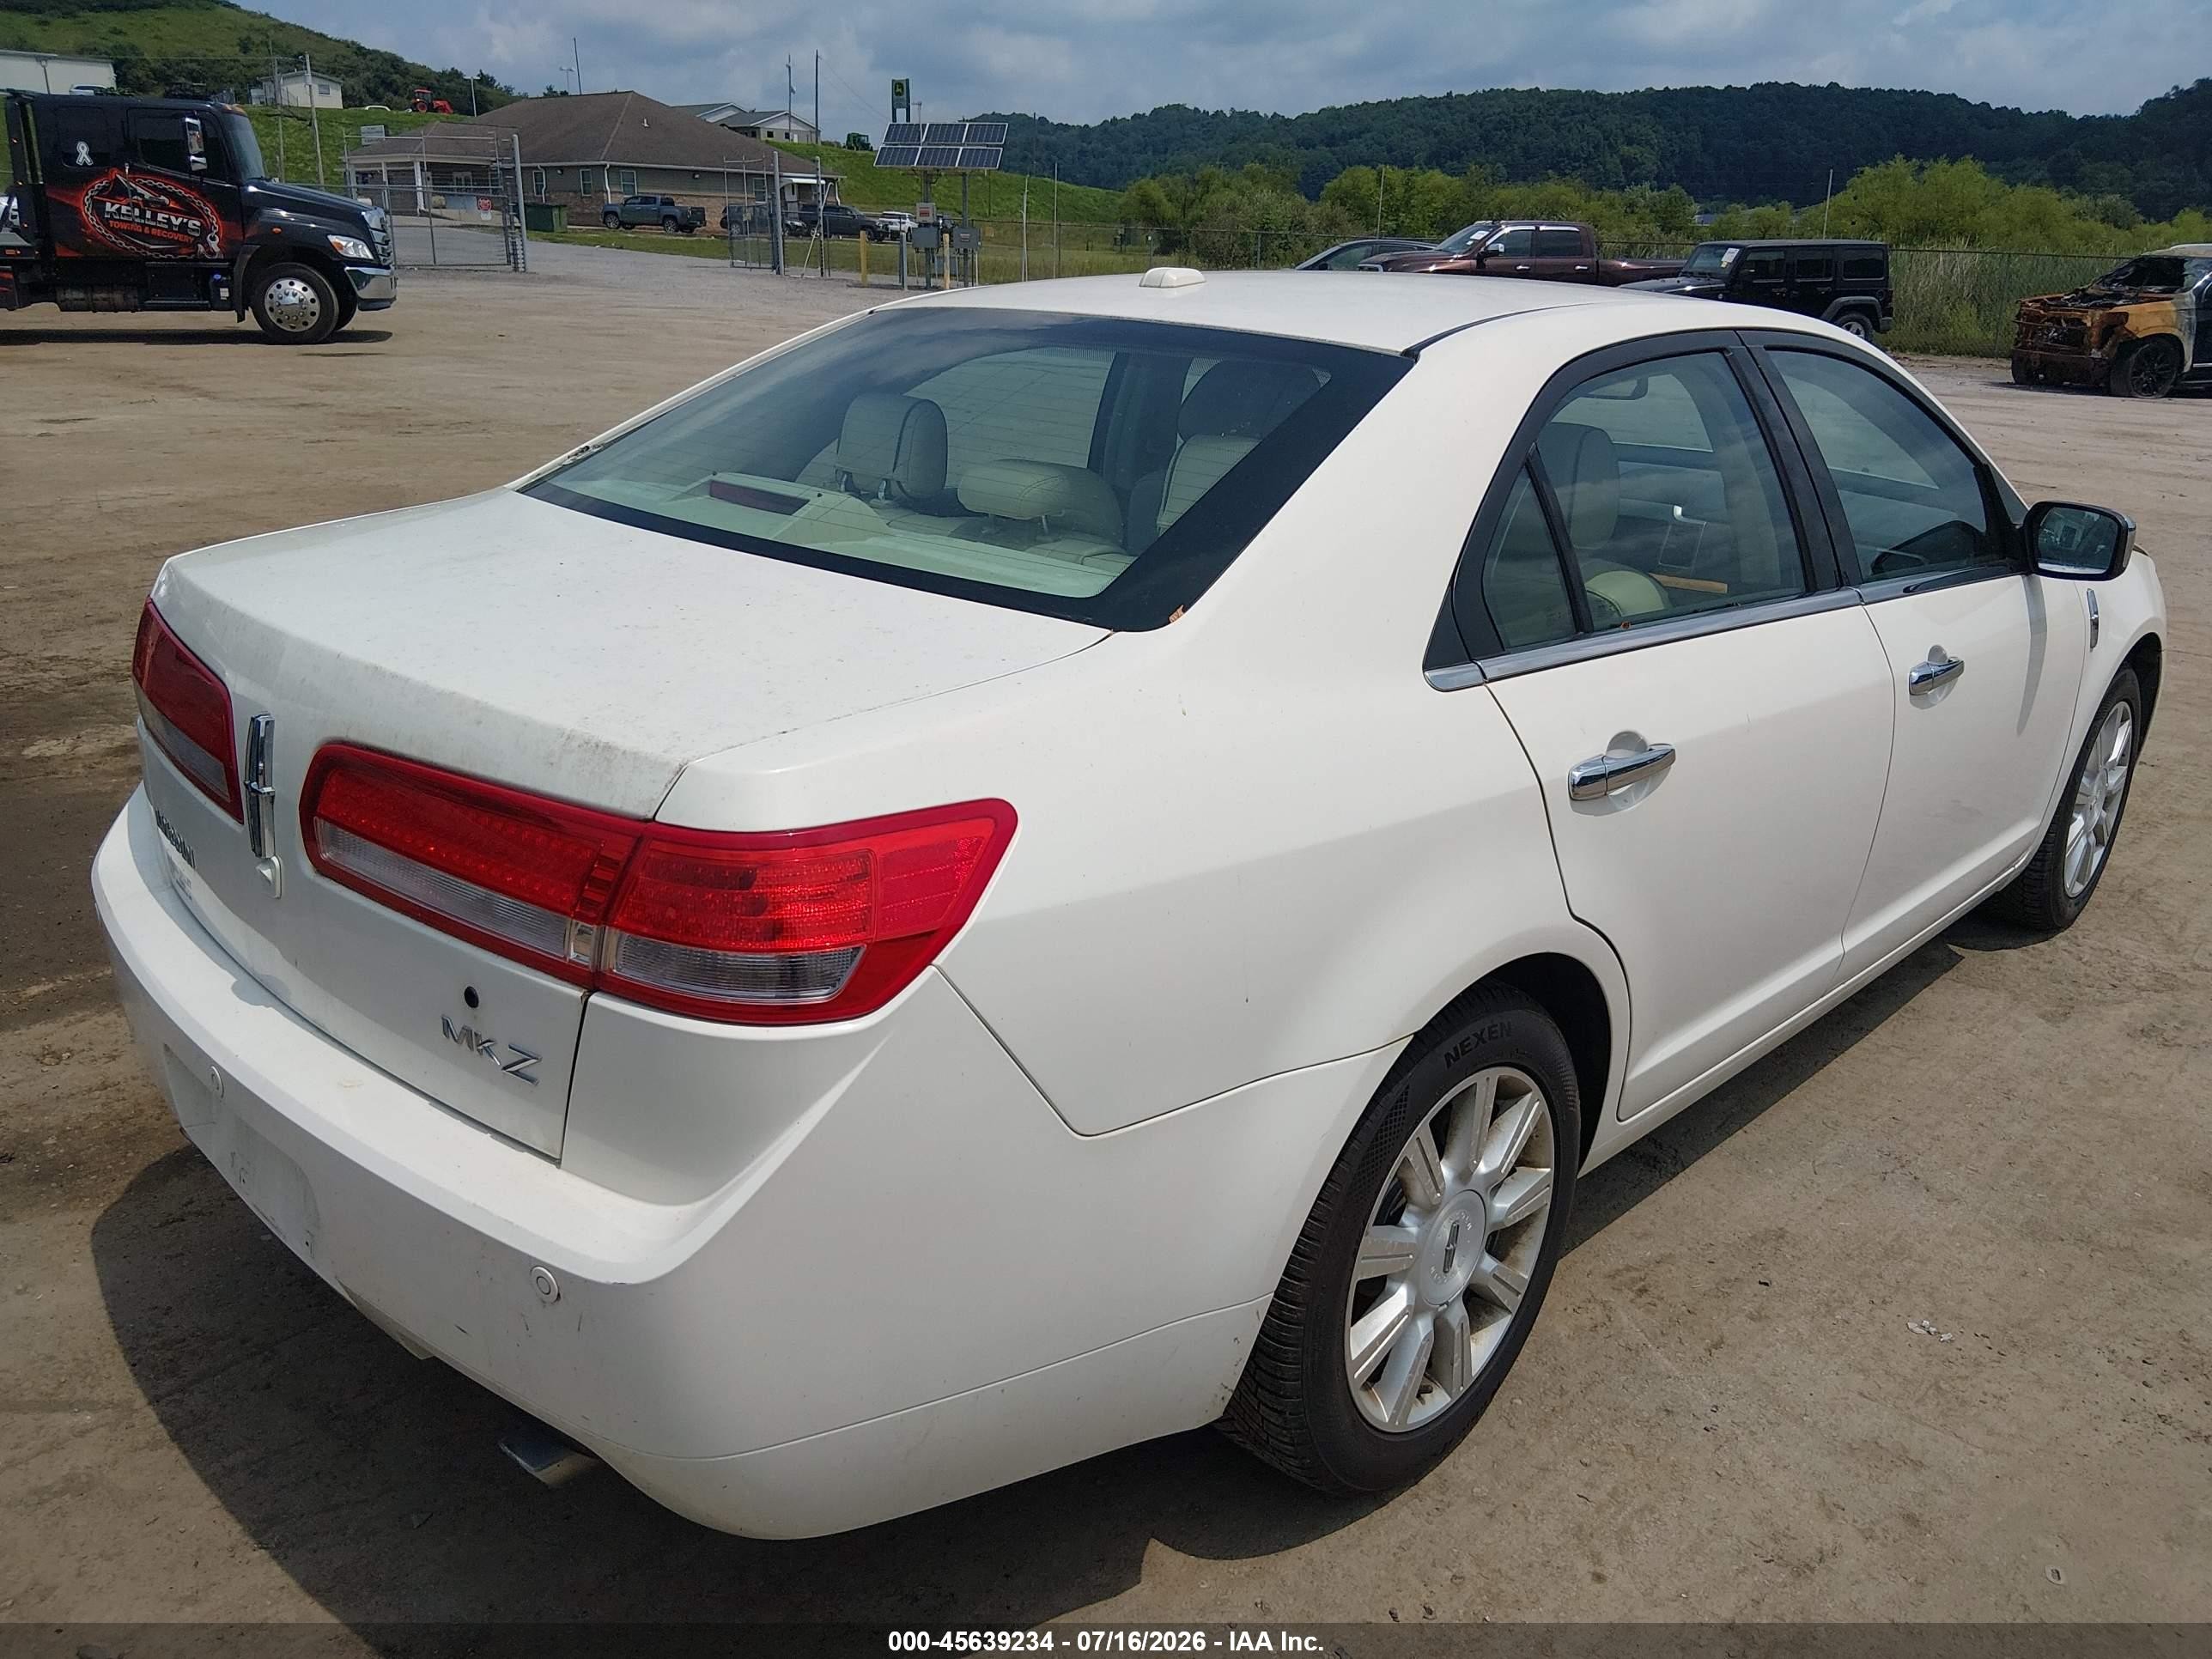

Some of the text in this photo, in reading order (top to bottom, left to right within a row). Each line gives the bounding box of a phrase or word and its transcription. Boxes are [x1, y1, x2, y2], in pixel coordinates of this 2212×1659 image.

[104, 202, 201, 237] KELLEY'S
[109, 220, 194, 243] TOWING & RECOVERY
[441, 1014, 543, 1086] MKZ
[1443, 1020, 1513, 1070] NEXEN
